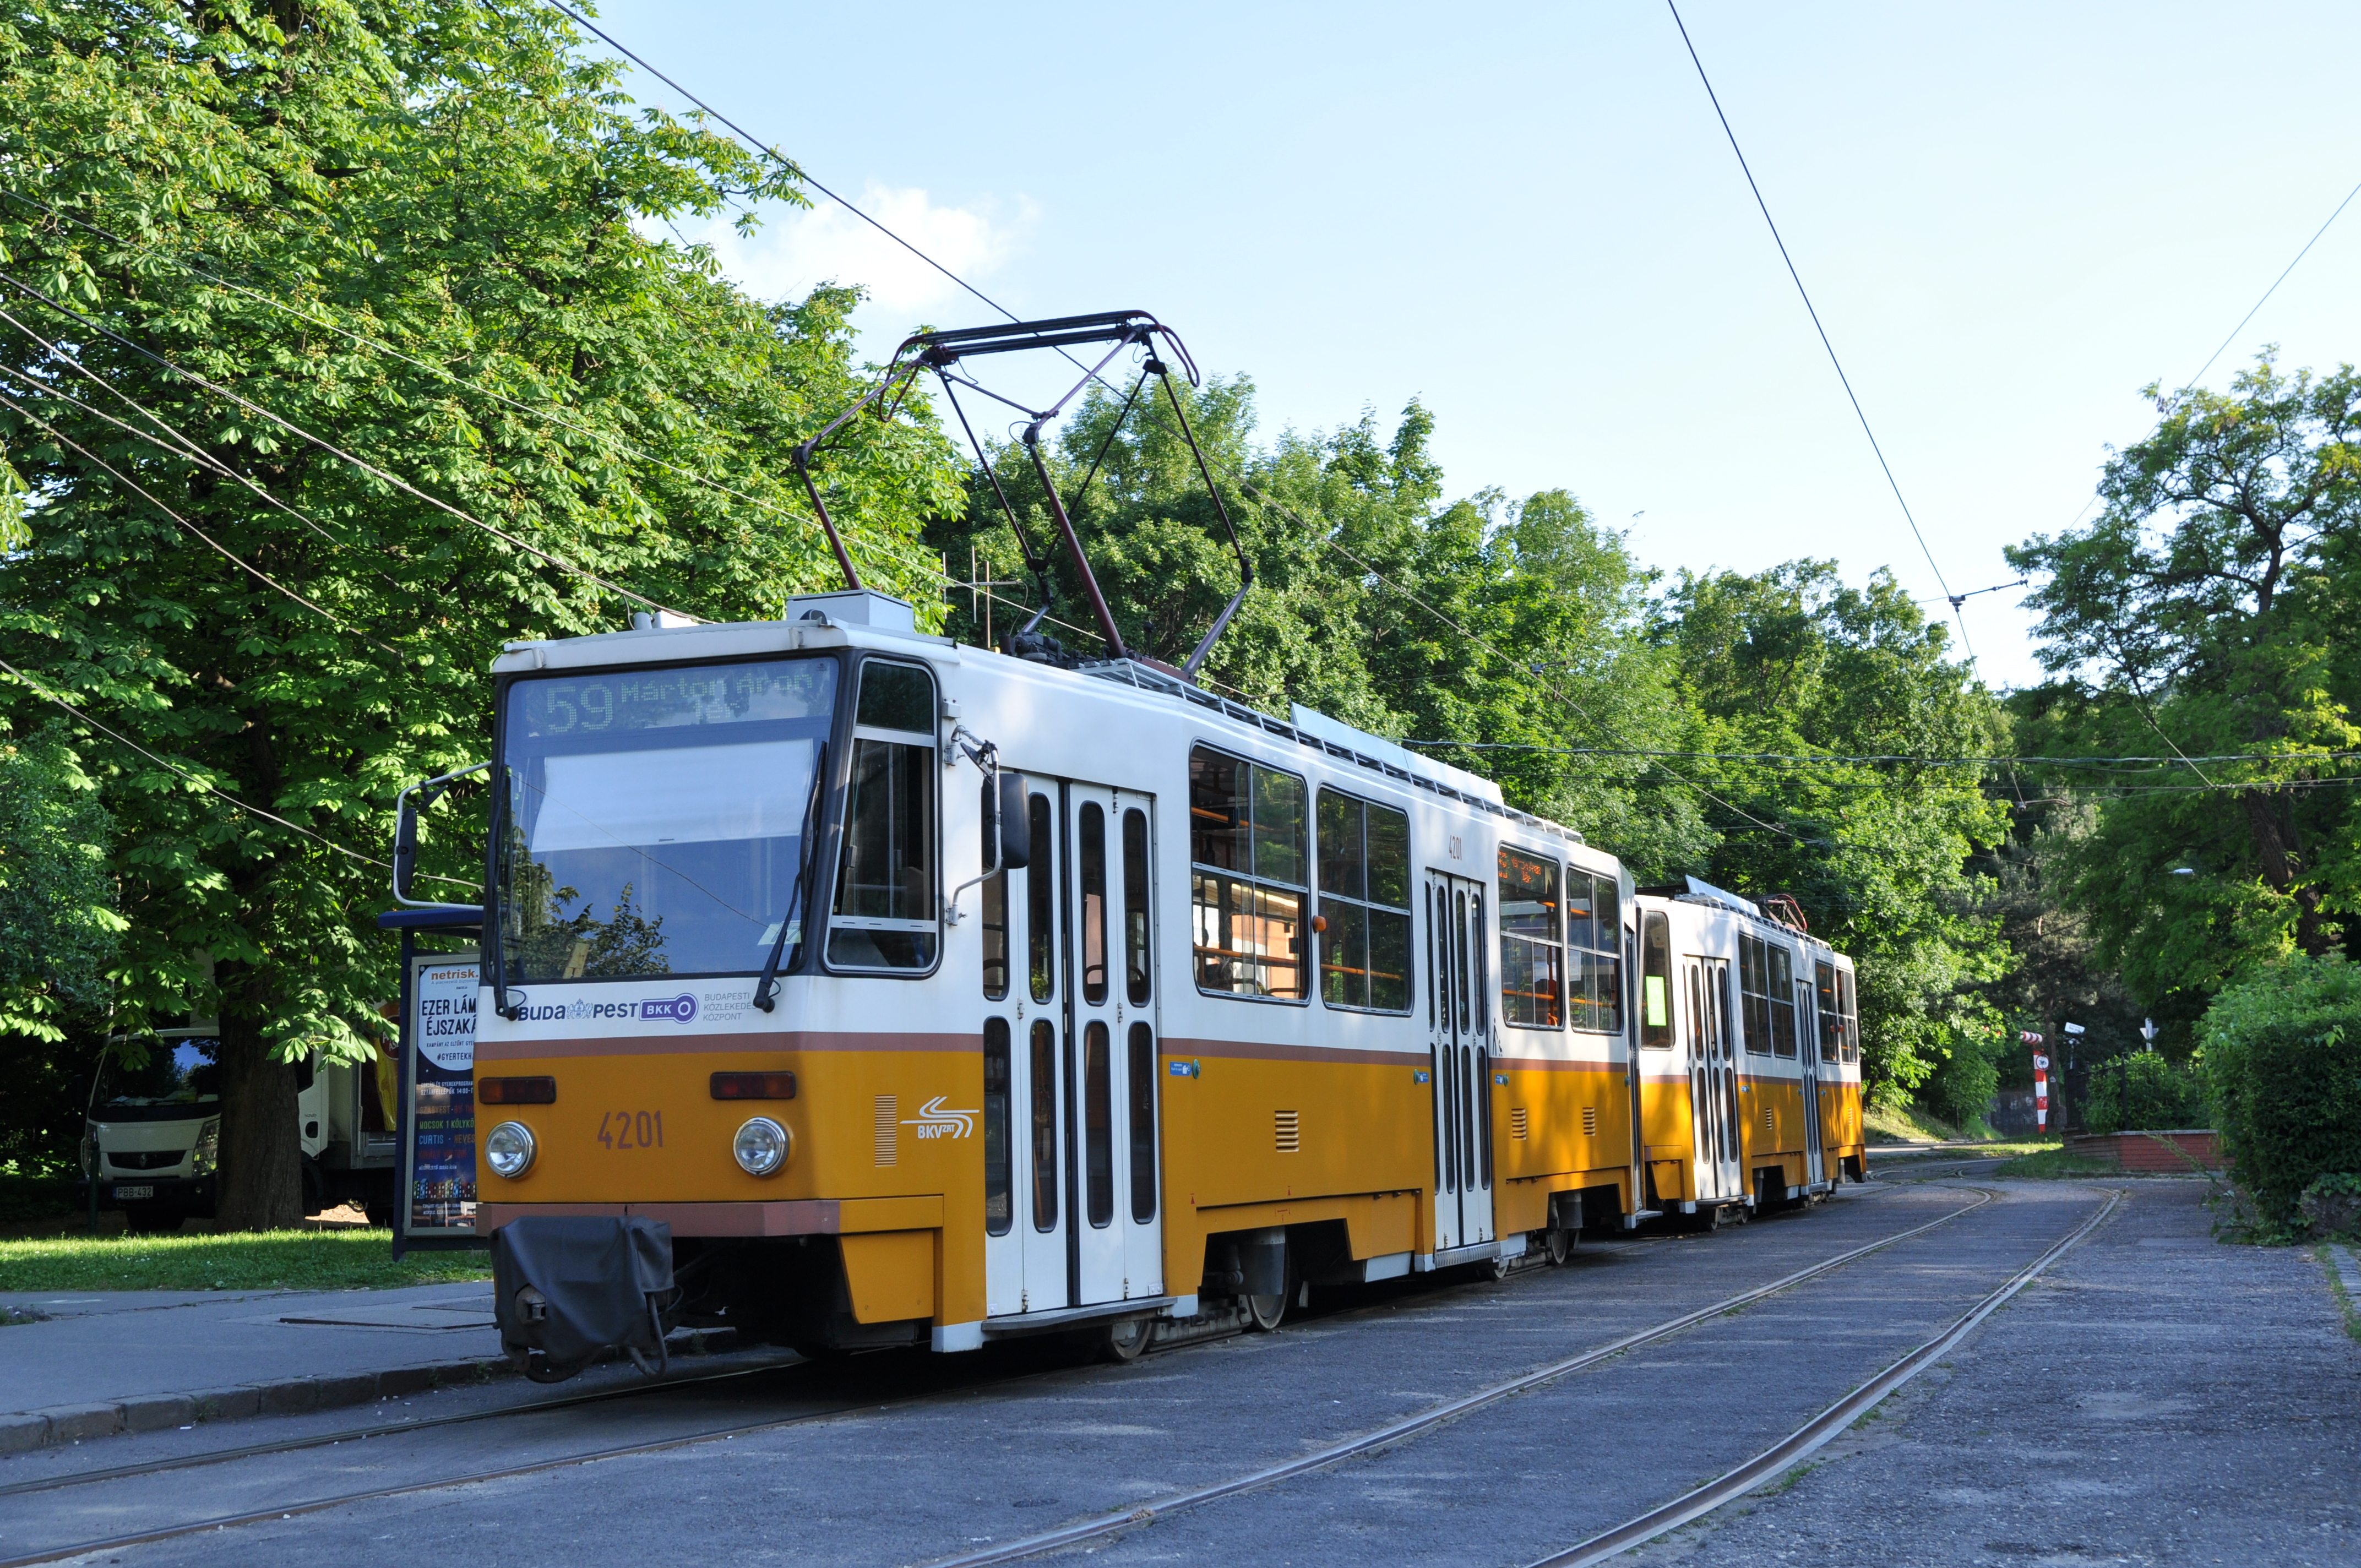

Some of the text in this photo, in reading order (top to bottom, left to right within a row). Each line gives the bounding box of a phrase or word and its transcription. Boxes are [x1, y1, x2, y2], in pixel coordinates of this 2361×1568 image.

[621, 673, 813, 703] Márton Áron
[547, 684, 612, 732] 59
[1449, 835, 1462, 861] 4201
[704, 992, 750, 1001] BUDAPESTI
[422, 994, 476, 1016] EZER LÁM
[646, 1004, 672, 1015] BKK
[703, 1012, 743, 1021] KÖZPONT
[419, 1120, 443, 1130] MOCSOK
[446, 1120, 449, 1129] 1
[597, 1110, 663, 1150] 4201
[418, 1135, 444, 1145] CURTIS
[117, 1187, 151, 1197] PBB-432
